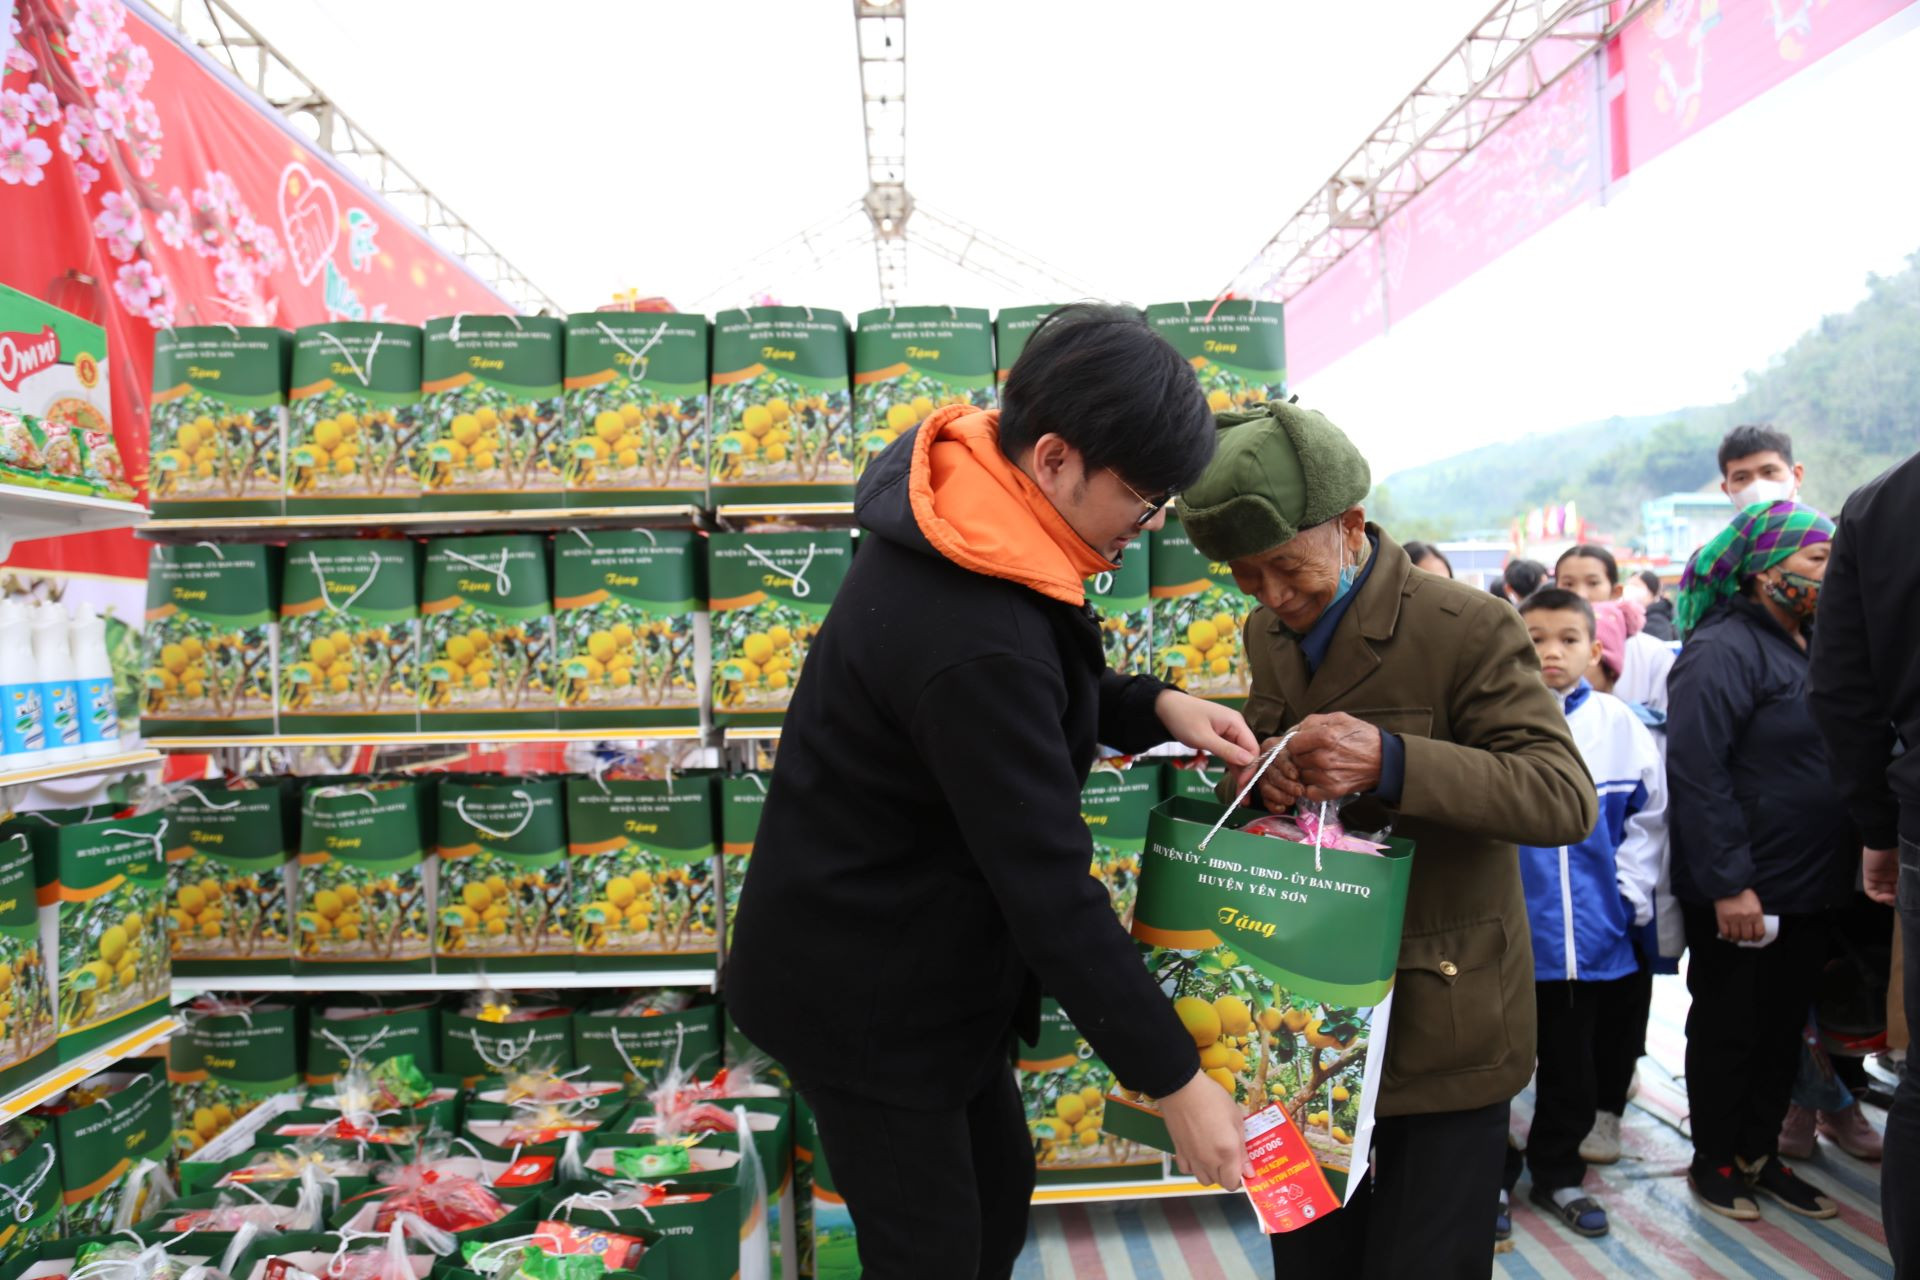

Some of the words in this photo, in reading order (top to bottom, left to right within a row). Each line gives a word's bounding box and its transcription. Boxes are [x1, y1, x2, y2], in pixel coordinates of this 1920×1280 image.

[0, 332, 56, 382] Omni
[1153, 843, 1183, 861] HUYỆN
[1185, 850, 1202, 865] ỦY
[1209, 858, 1242, 873] HĐND
[1250, 866, 1283, 881] UBND
[1291, 870, 1308, 886] ỦY
[1309, 877, 1333, 890] BAN
[1335, 883, 1371, 899] MTTQ
[1197, 873, 1244, 892] HUYỆN
[1249, 882, 1276, 898] YÊN
[1280, 890, 1309, 904] SƠN
[1217, 906, 1278, 939] Tặng
